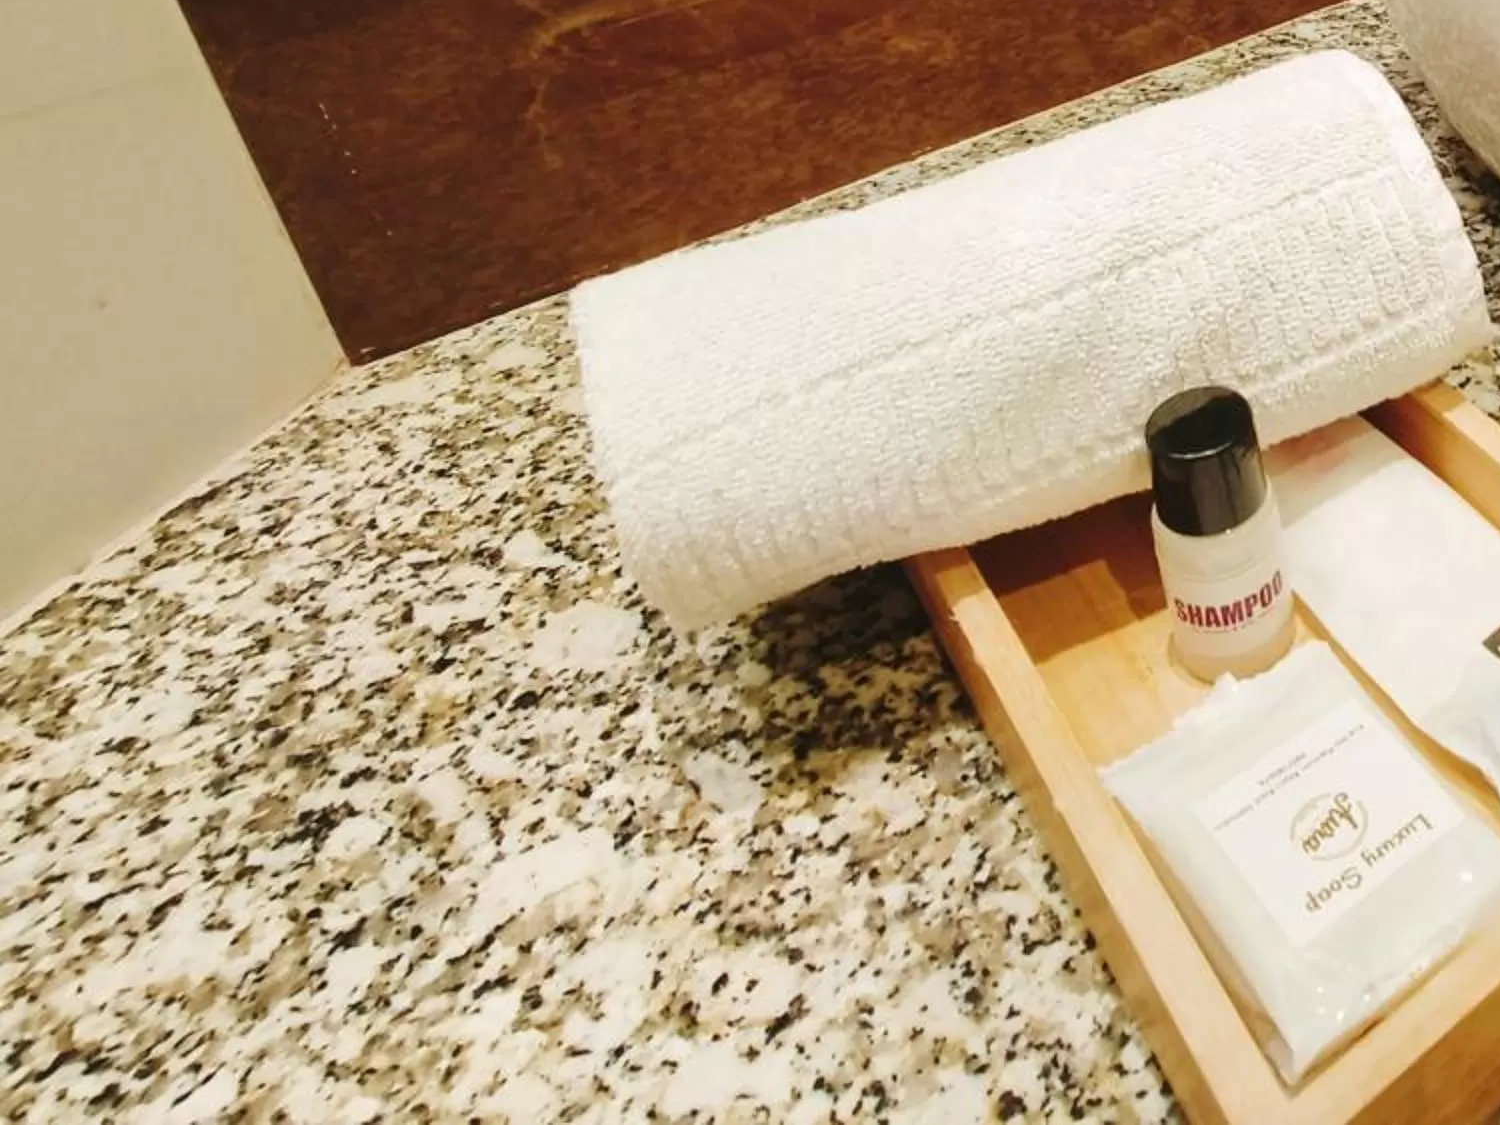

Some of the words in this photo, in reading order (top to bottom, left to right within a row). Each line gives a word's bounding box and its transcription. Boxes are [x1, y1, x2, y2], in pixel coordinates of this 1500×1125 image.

[1174, 570, 1282, 628] SHAMPOO
[1360, 812, 1433, 867] Luxury
[1305, 866, 1363, 913] Soap
